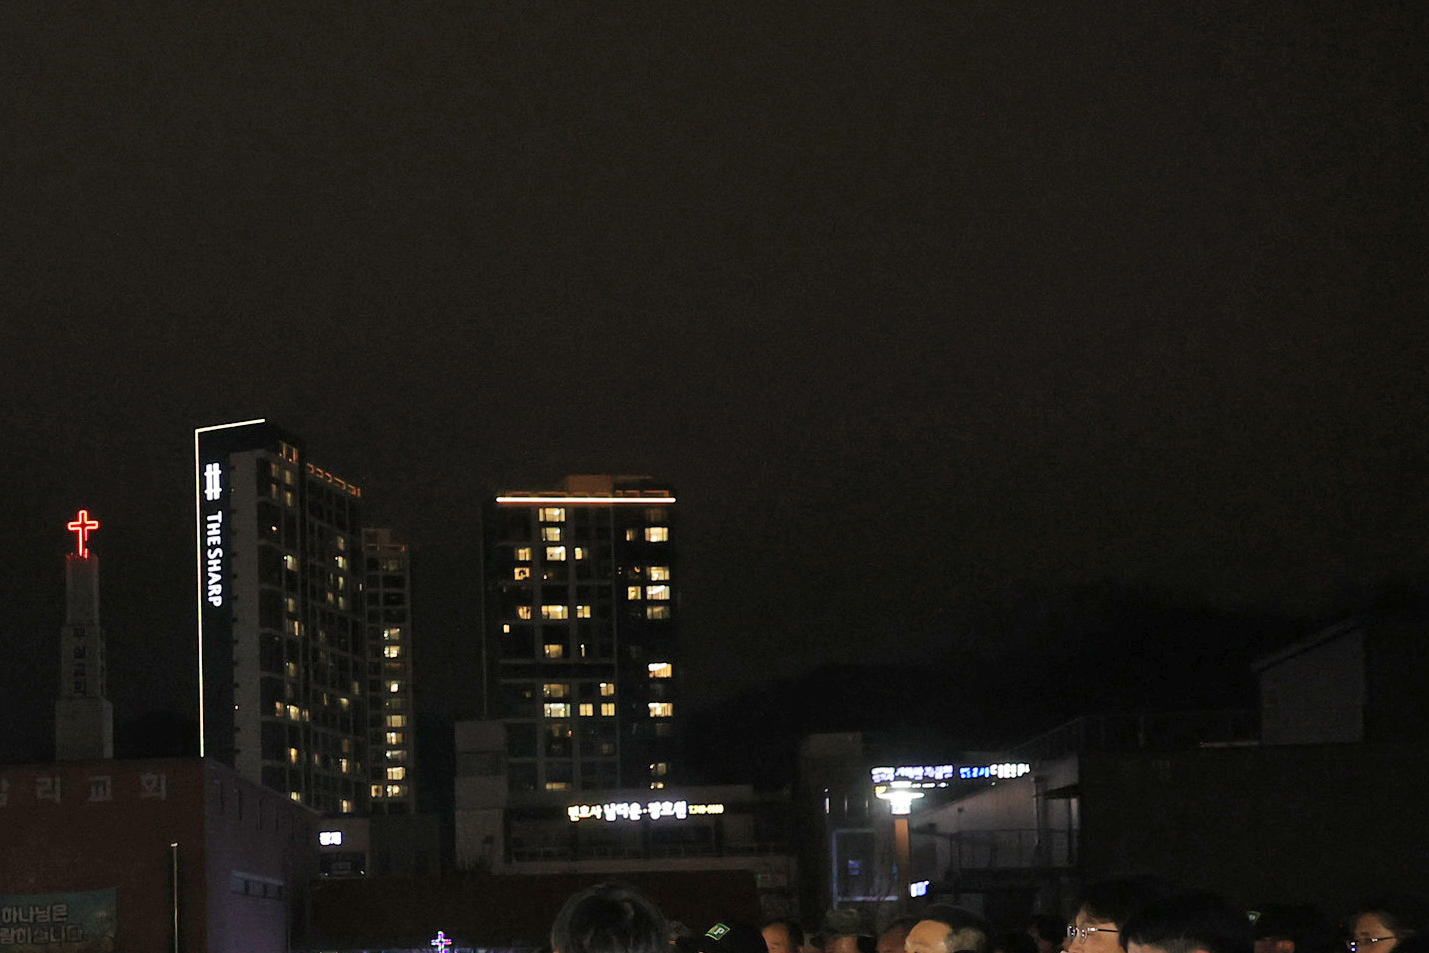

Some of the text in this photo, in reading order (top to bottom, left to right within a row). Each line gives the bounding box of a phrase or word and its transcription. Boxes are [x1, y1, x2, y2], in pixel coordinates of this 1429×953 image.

[206, 511, 223, 607] THE SHARP
[1, 903, 68, 924] 하나님은
